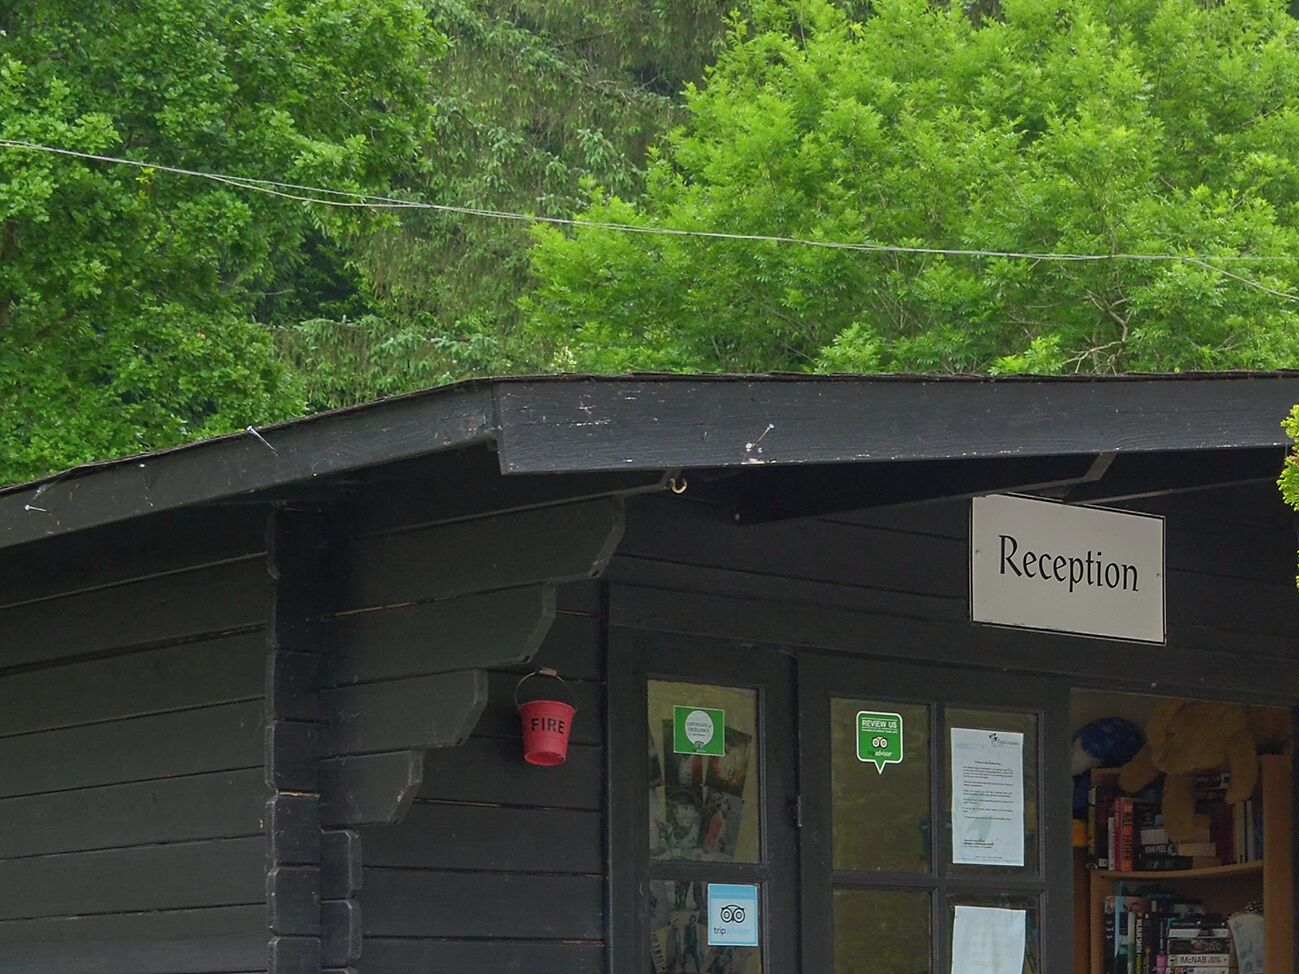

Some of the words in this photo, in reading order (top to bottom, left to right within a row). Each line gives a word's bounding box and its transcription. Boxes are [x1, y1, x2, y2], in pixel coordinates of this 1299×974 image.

[998, 534, 1139, 593] Reception
[531, 717, 566, 735] FIRE
[862, 719, 887, 728] REVIEW
[888, 721, 897, 729] US
